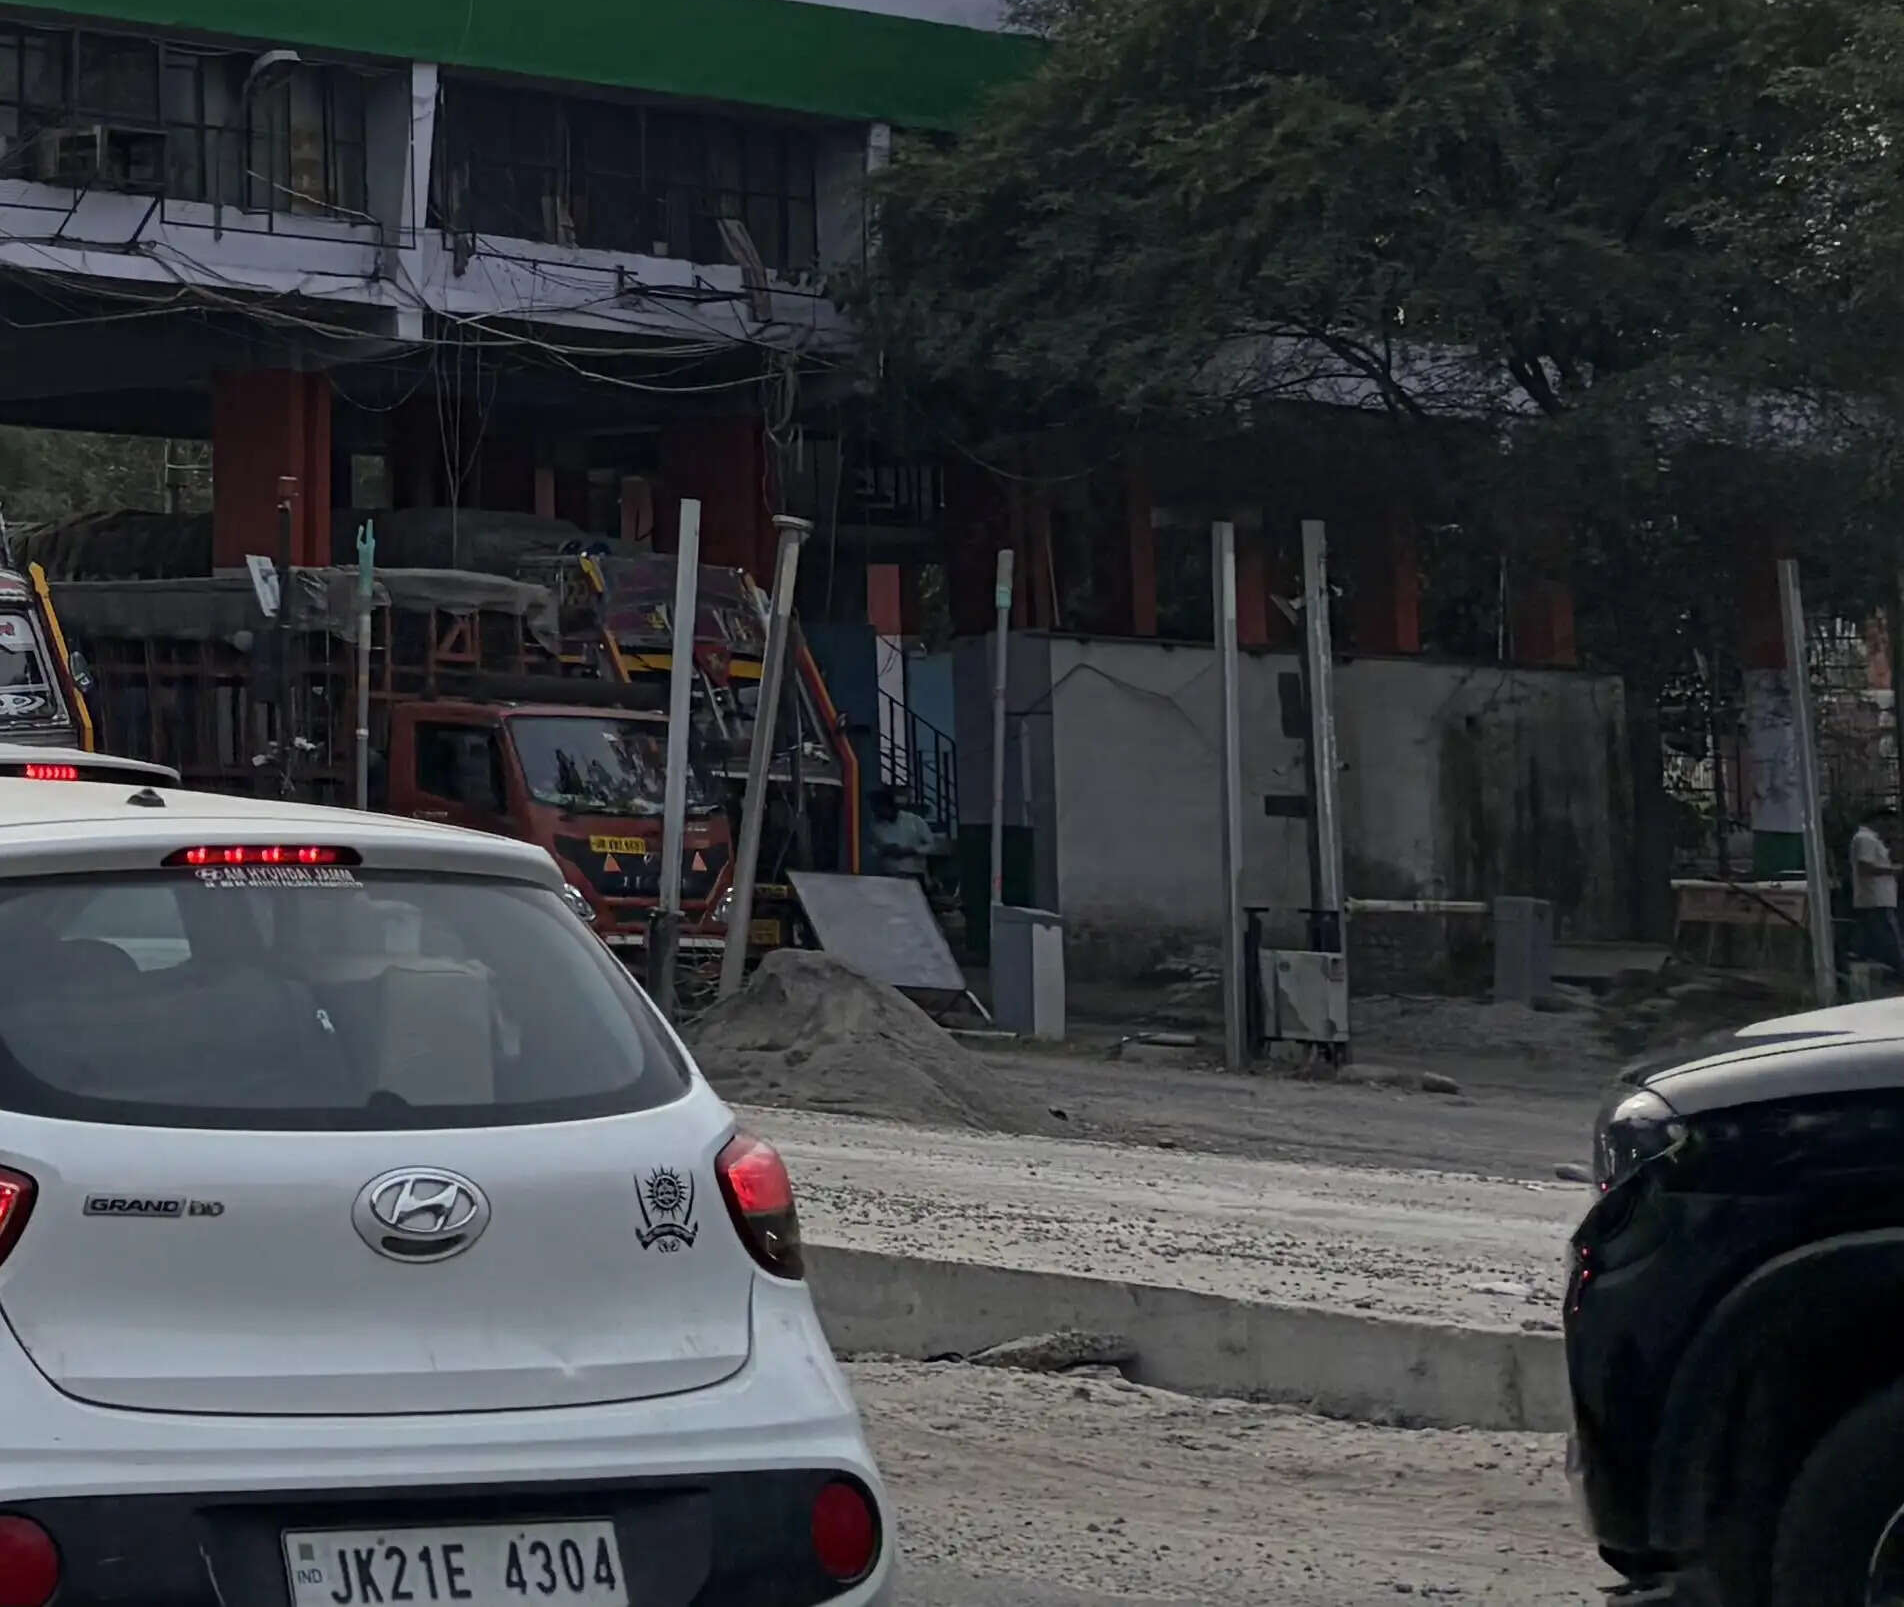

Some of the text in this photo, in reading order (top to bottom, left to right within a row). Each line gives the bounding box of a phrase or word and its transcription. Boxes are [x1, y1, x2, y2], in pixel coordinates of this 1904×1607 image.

[90, 1199, 180, 1212] GRAND
[297, 1569, 323, 1584] IND
[331, 1536, 616, 1604] JK21E 4304
